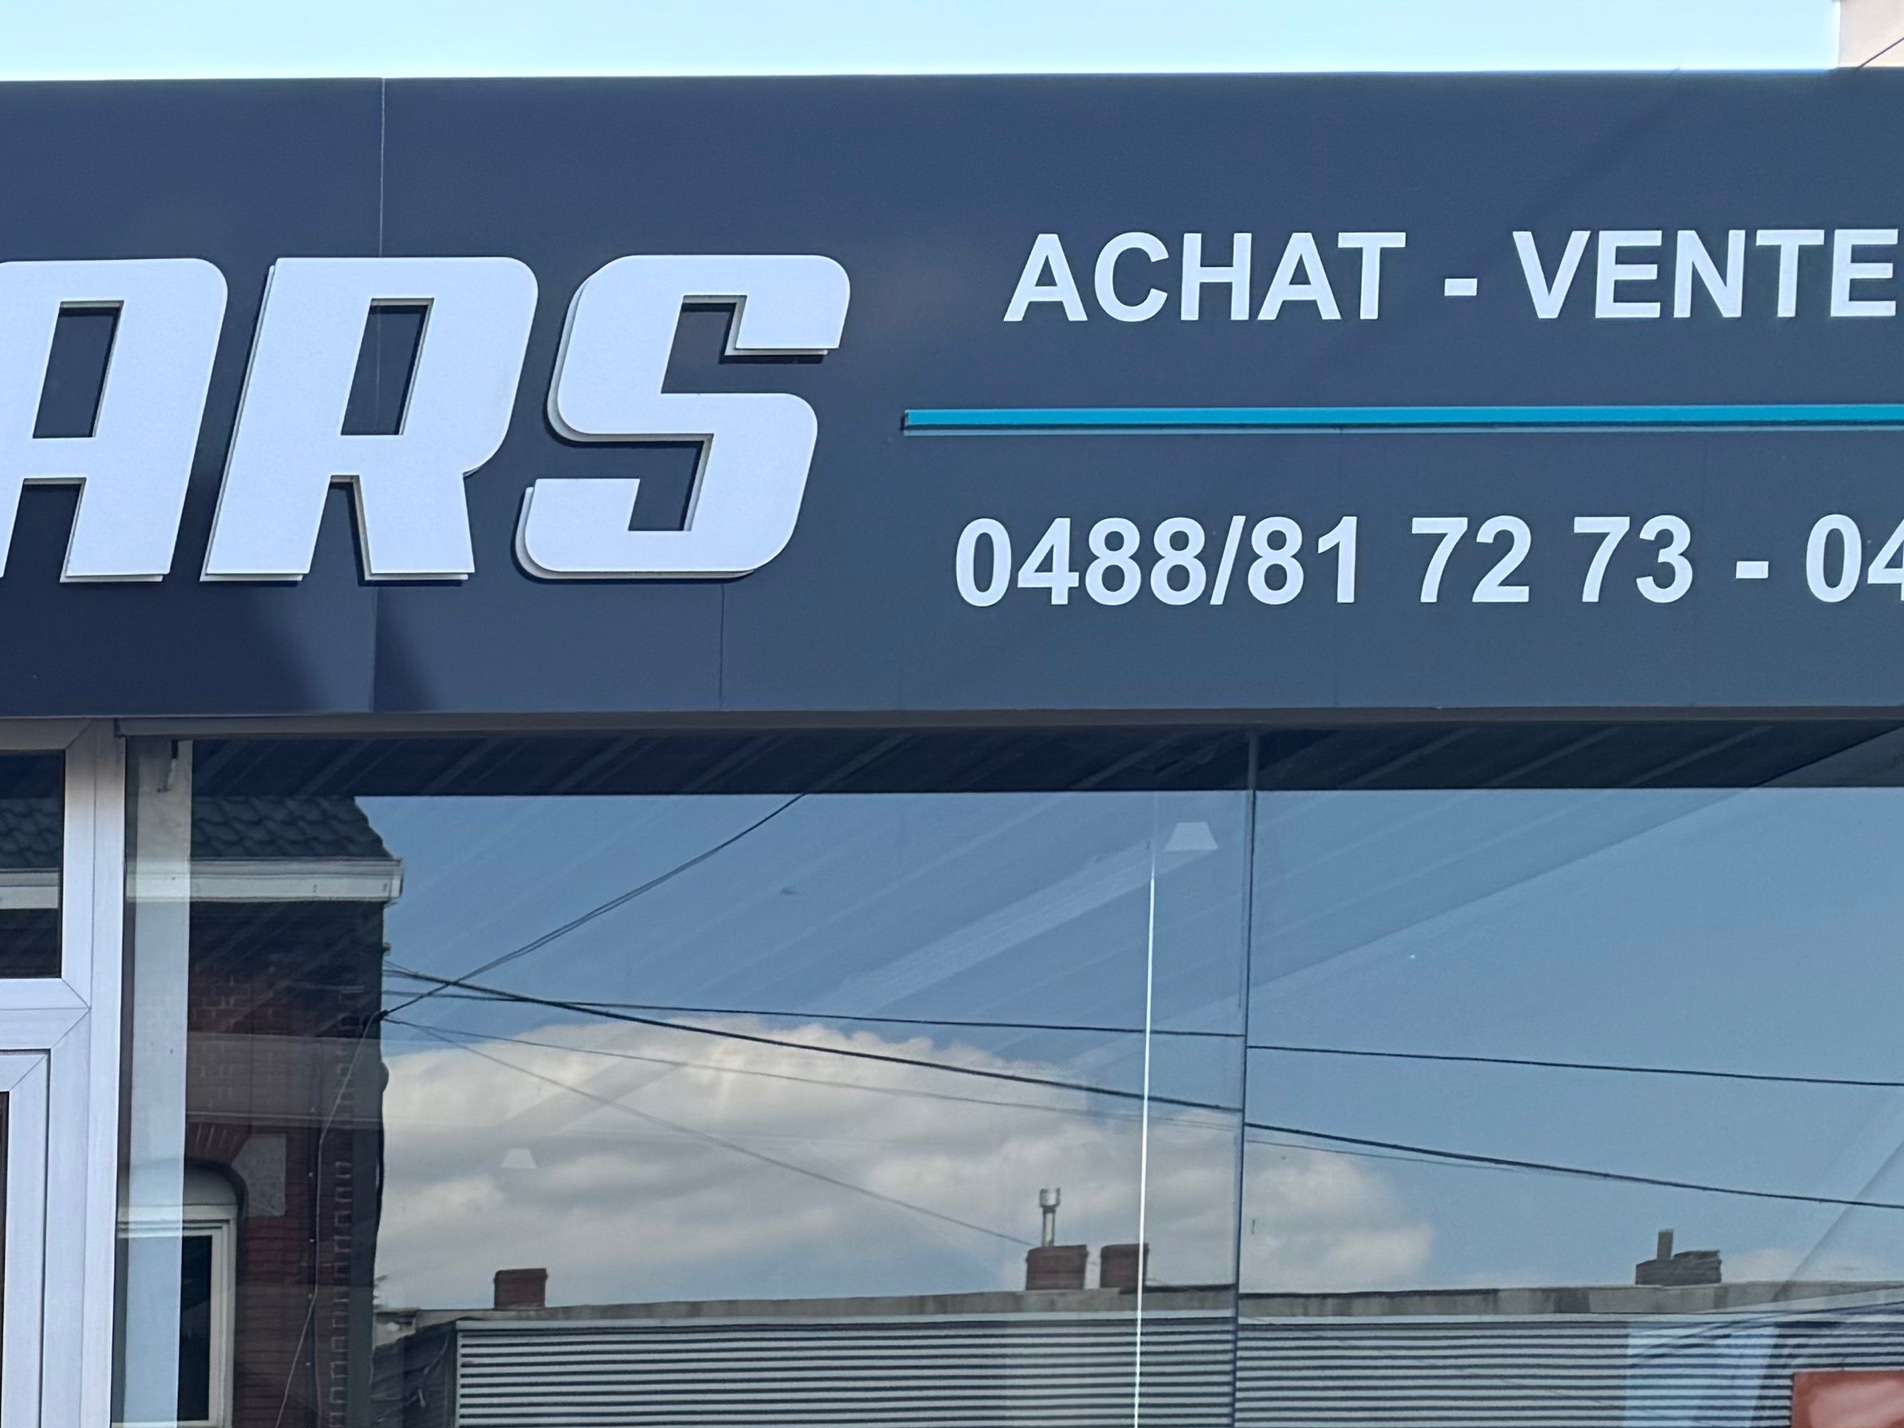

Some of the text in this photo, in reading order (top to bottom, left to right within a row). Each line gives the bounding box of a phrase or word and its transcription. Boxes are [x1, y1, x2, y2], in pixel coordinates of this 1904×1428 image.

[1004, 231, 1406, 322] ACHAT
[1513, 228, 1899, 319] VENTE
[955, 514, 1359, 607] 0488/81
[1411, 515, 1532, 604] 72
[1573, 514, 1693, 604] 73
